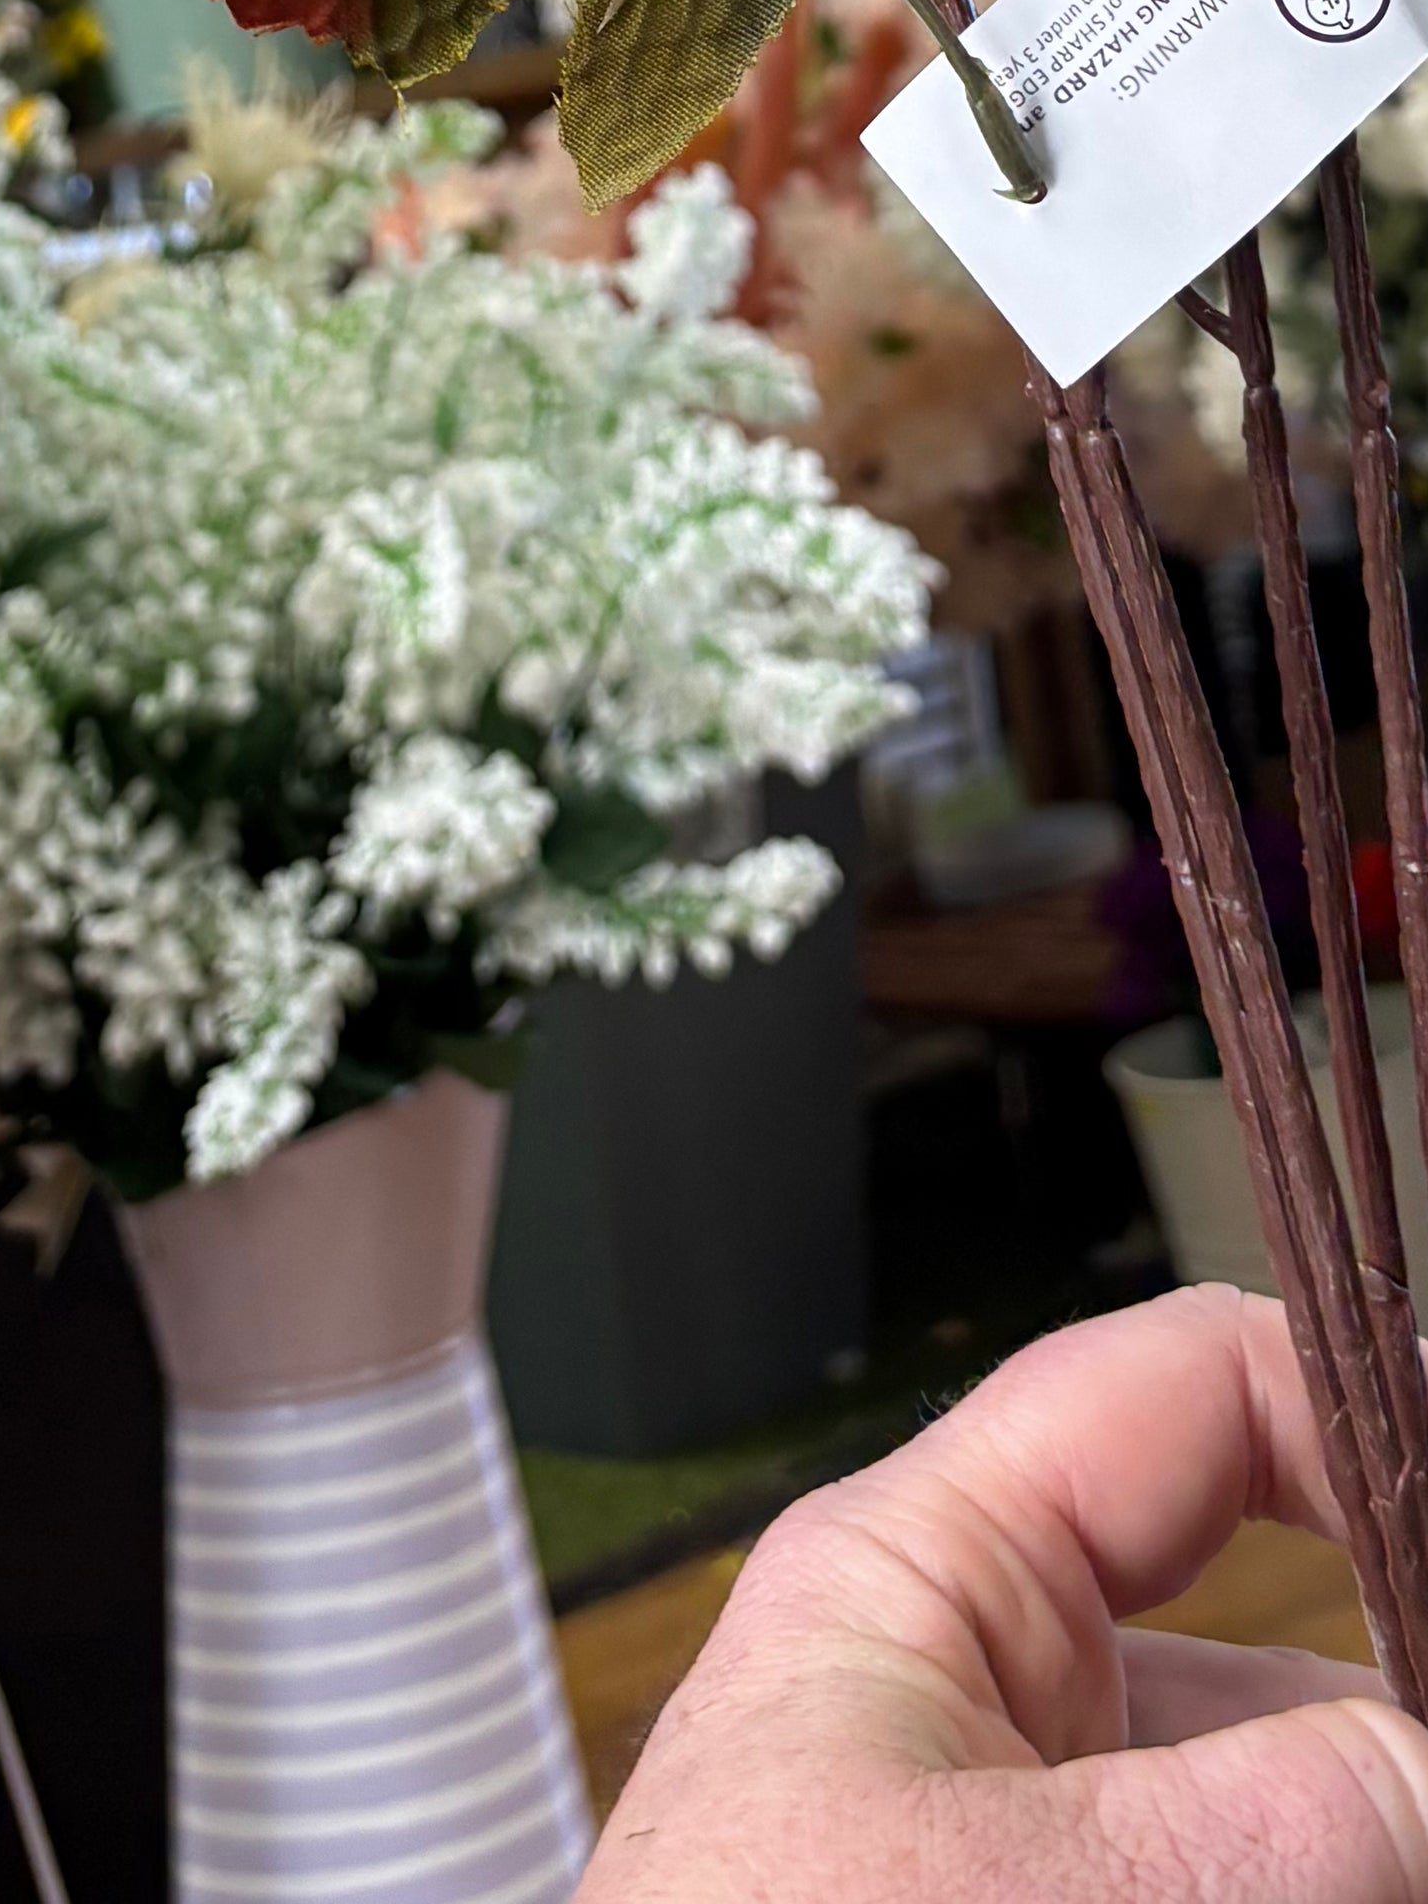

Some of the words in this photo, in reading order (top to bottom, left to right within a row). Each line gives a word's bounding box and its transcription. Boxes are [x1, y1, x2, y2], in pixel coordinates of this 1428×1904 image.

[1035, 3, 1083, 52] under
[1050, 12, 1107, 73] SHARP
[993, 55, 1025, 87] yea
[1022, 46, 1040, 64] 3
[1053, 20, 1140, 105] HAZARD
[1008, 67, 1051, 108] EDG
[1017, 104, 1046, 134] an
